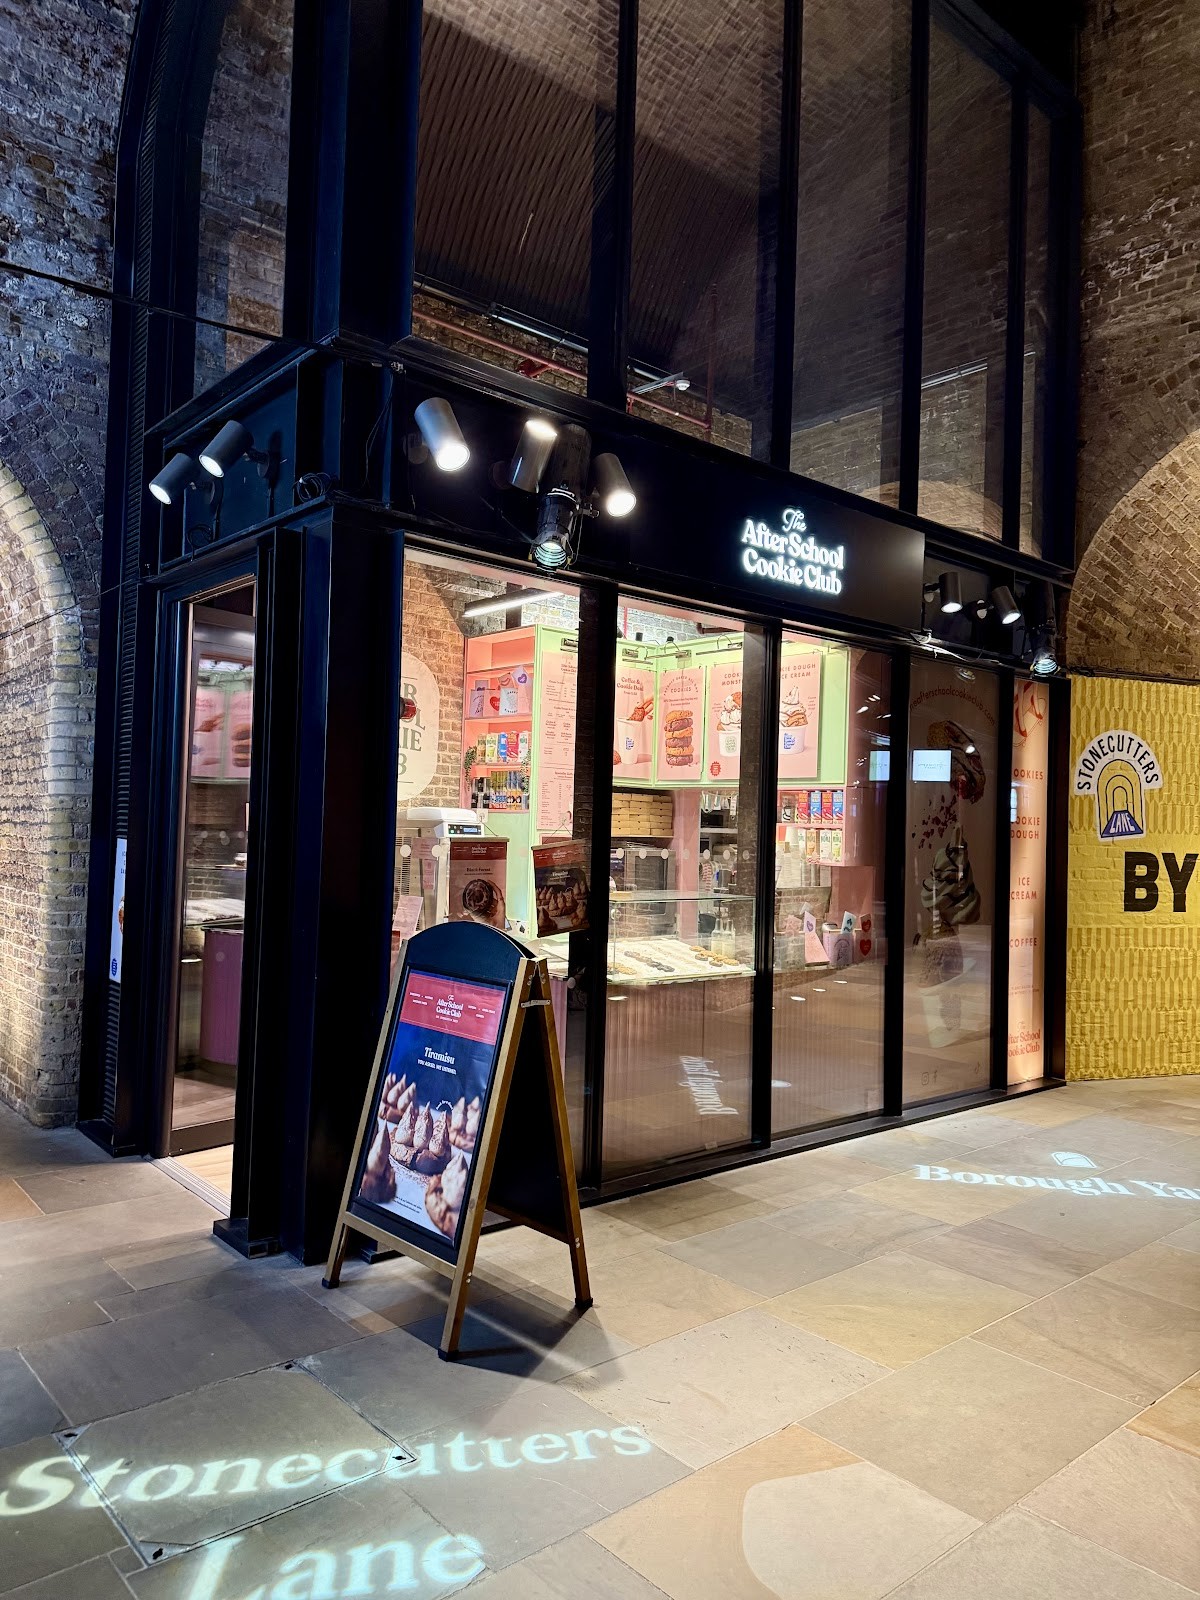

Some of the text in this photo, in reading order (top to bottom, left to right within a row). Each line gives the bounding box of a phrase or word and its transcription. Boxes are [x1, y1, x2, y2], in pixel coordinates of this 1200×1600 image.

[782, 507, 807, 532] The
[741, 518, 845, 570] After School
[743, 548, 842, 594] Cookie Club
[793, 663, 816, 671] DOUGH
[790, 671, 811, 679] CREAM
[1077, 734, 1160, 790] STONECUTTERS
[1013, 768, 1044, 780] OOKIES
[1011, 816, 1040, 826] OOKIE
[1109, 812, 1136, 834] LANE
[1010, 829, 1040, 840] DOUGH
[1018, 877, 1030, 886] ICE
[1123, 851, 1199, 913] BY
[1010, 890, 1037, 900] CREAM
[1010, 937, 1037, 948] COFFEE
[436, 1006, 450, 1016] Cookie
[450, 1008, 462, 1018] Club
[447, 1000, 464, 1011] School
[1020, 1029, 1041, 1043] School
[1025, 1042, 1040, 1054] Club
[424, 1046, 455, 1065] Tiramisu
[913, 1164, 1135, 1196] Borough
[2, 1422, 652, 1516] Stonecutters
[178, 1533, 486, 1600] Lane
